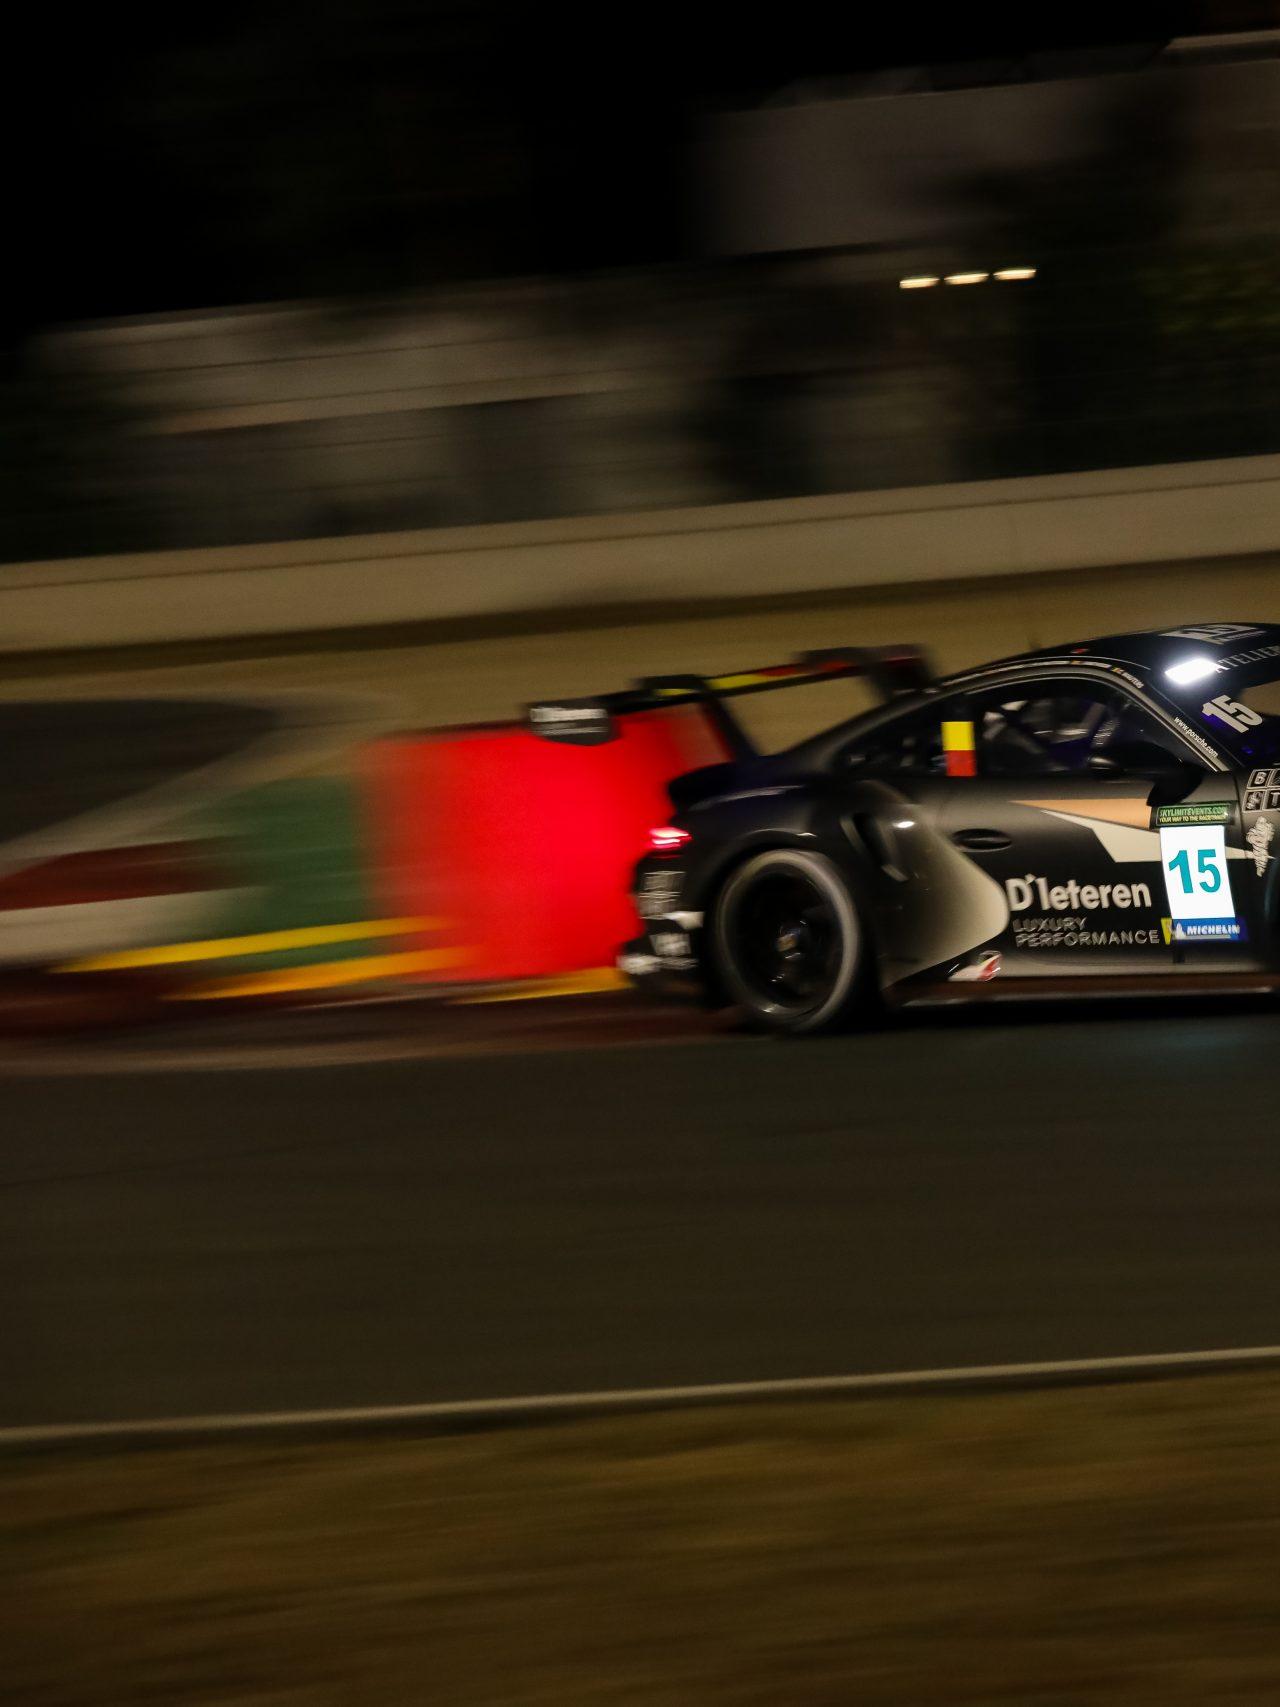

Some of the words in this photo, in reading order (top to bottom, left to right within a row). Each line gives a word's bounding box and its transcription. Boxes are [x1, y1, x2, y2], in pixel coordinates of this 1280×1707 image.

[1201, 694, 1263, 733] 15
[1174, 716, 1219, 758] www.porsche.com
[1168, 848, 1222, 894] 15
[1012, 916, 1088, 933] LUXURY
[1014, 929, 1161, 948] PERFORMANCE
[1186, 924, 1241, 936] MICHELIN
